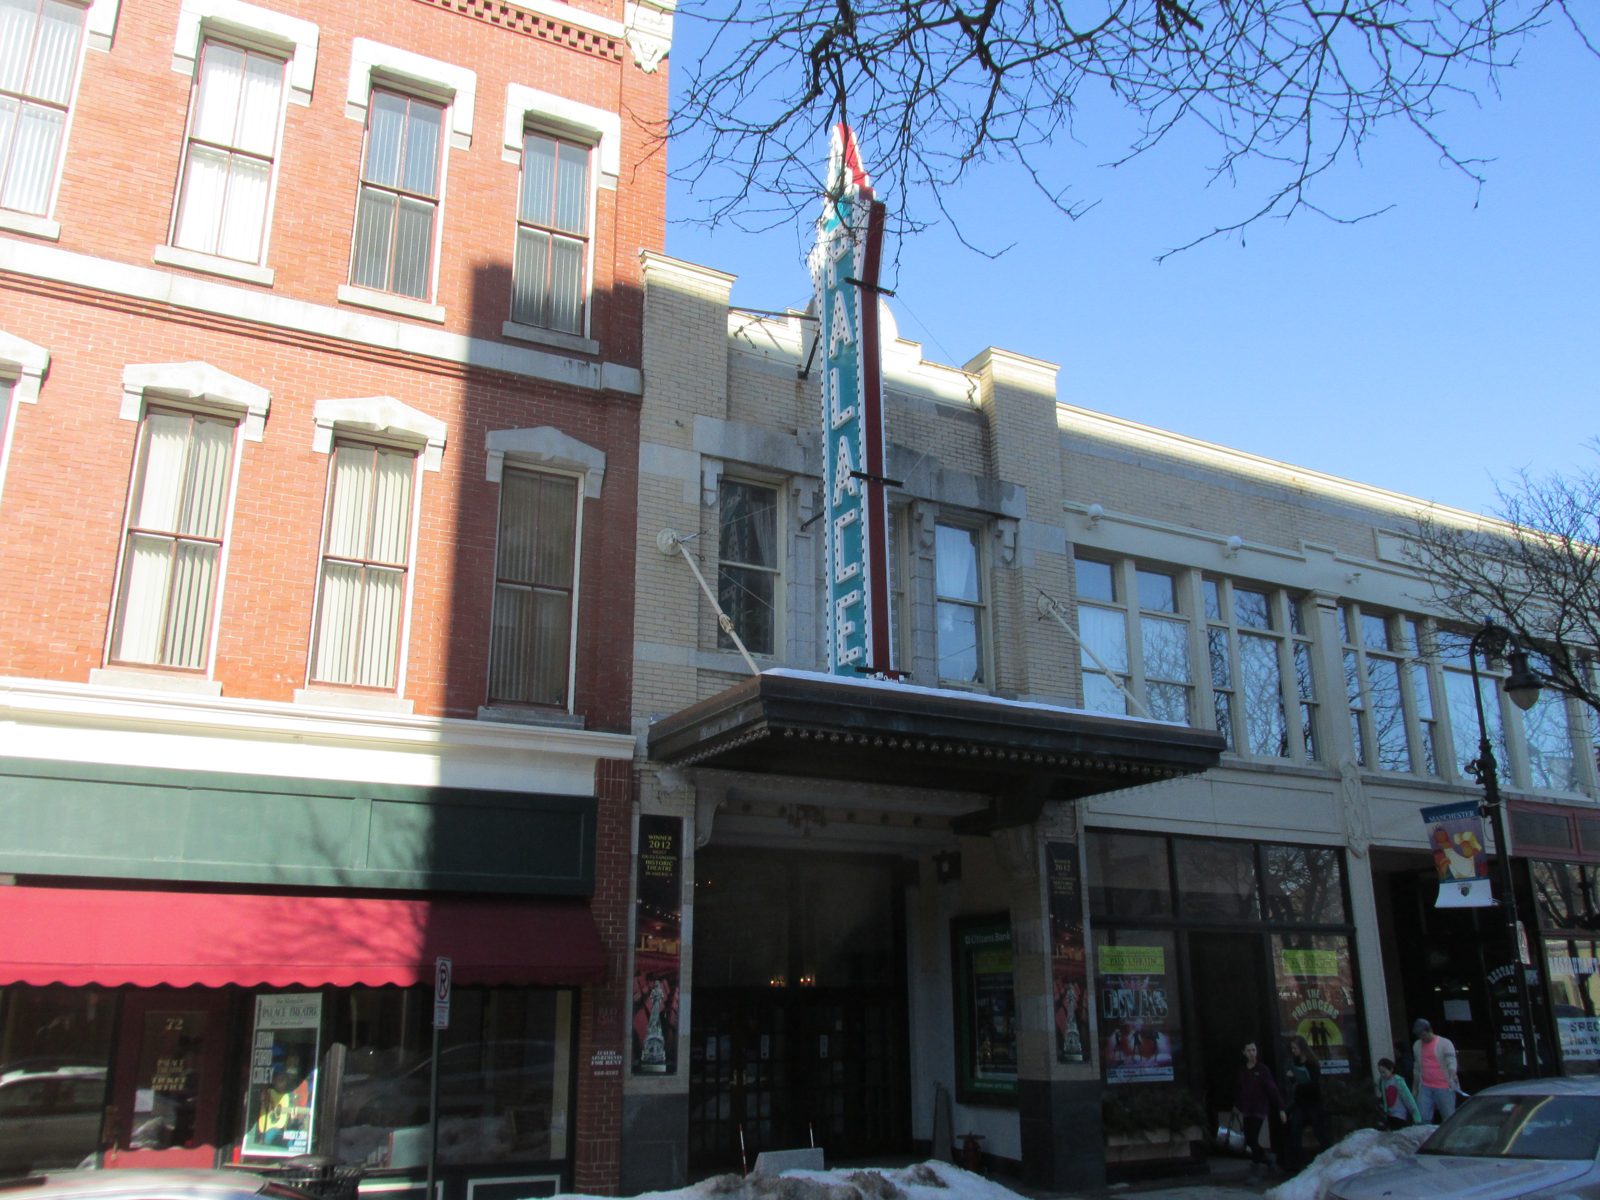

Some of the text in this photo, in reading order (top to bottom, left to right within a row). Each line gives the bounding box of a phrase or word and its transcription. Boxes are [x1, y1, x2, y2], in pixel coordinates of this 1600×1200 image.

[827, 220, 863, 667] PALACE
[1429, 811, 1475, 822] MANCHESTER
[649, 841, 671, 849] 2012
[1055, 864, 1071, 872] 2012
[993, 931, 1011, 942] Bank
[1307, 988, 1321, 998] THE
[1103, 989, 1168, 1018] DIVAS
[1292, 999, 1339, 1020] PRODUCERS
[166, 1018, 184, 1031] 72
[255, 1049, 273, 1065] FORD
